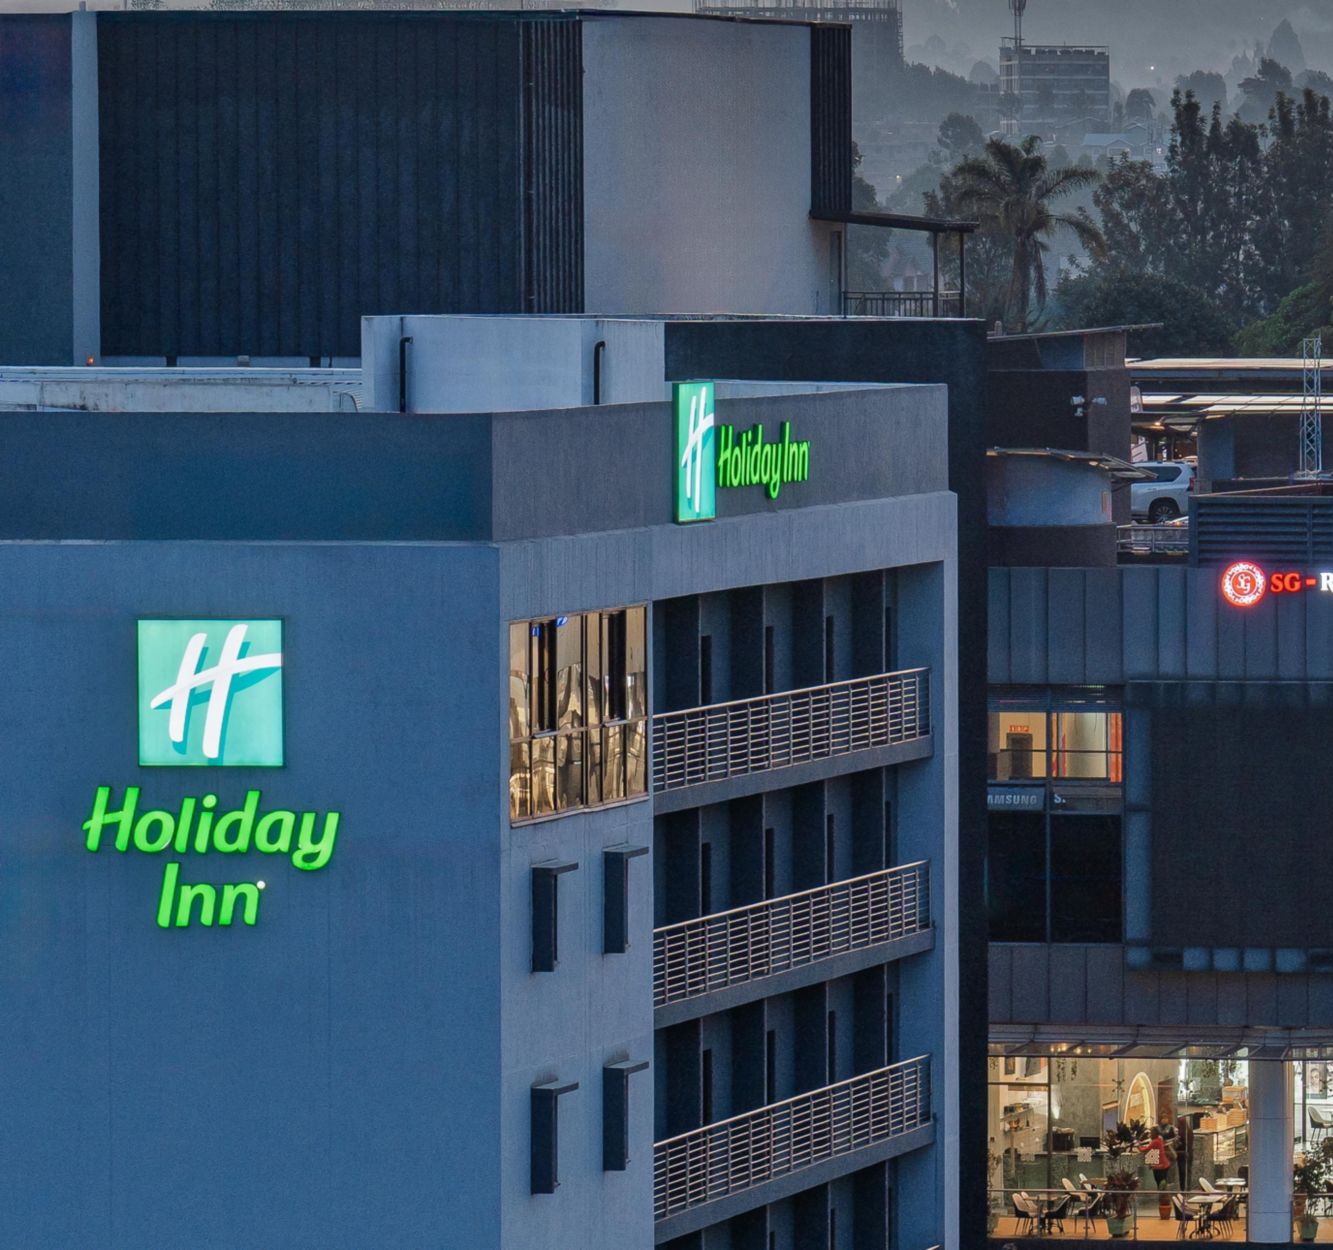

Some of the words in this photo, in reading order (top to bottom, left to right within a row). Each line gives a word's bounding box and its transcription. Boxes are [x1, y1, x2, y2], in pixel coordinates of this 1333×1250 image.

[718, 424, 782, 499] Holiday
[783, 421, 810, 484] Inn
[1270, 572, 1301, 593] SG
[82, 785, 341, 871] Holiday
[156, 862, 260, 928] Inn
